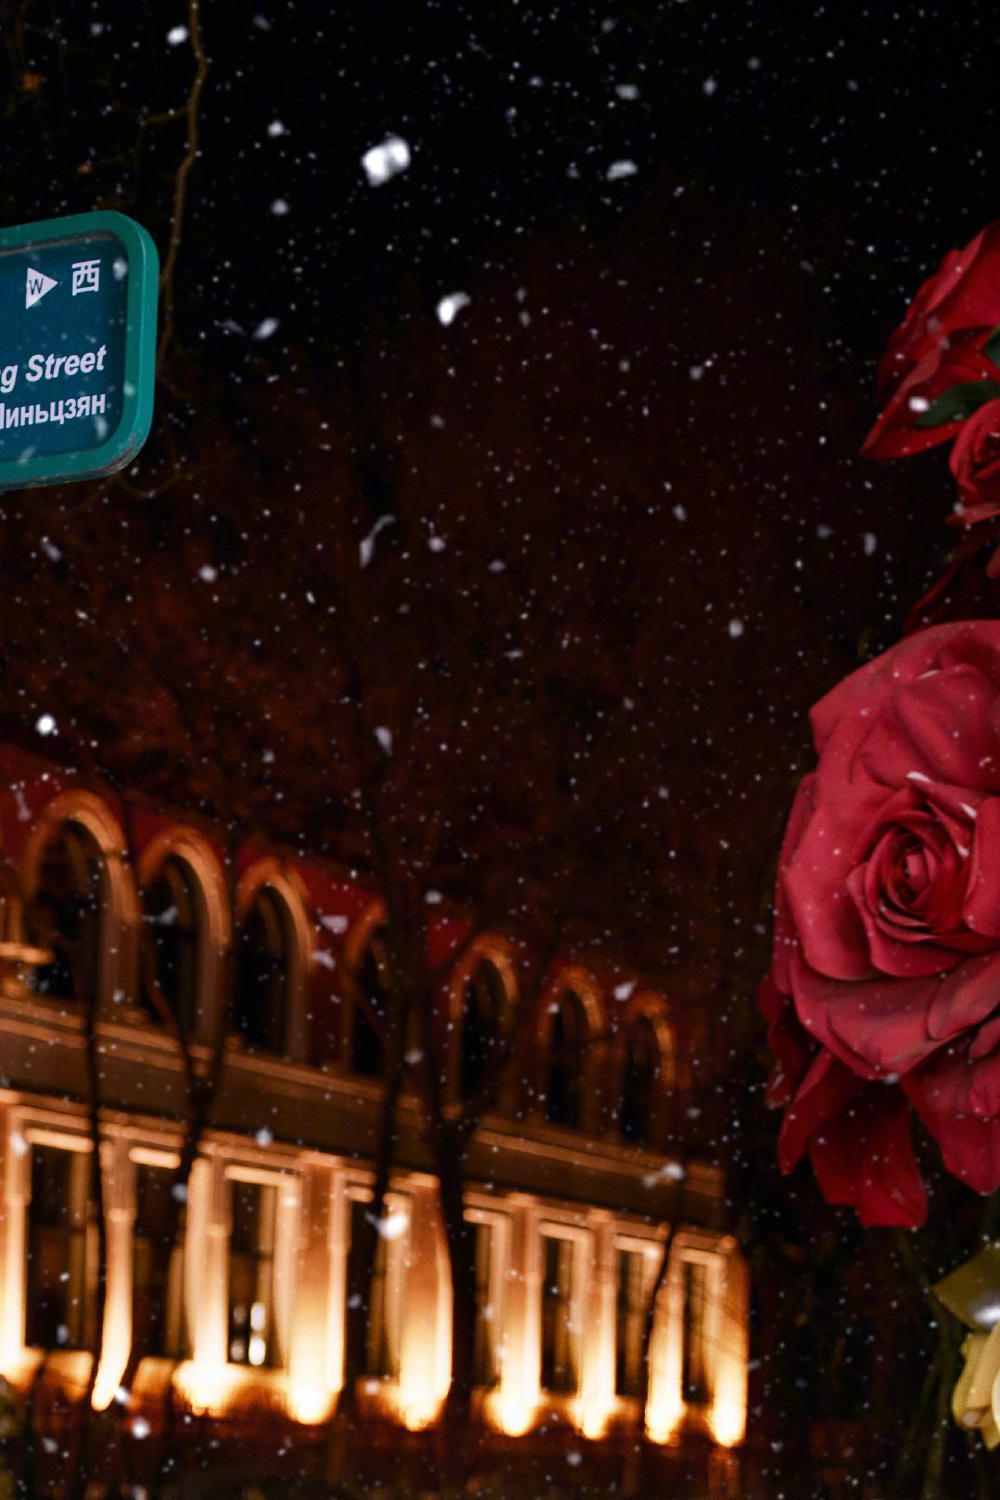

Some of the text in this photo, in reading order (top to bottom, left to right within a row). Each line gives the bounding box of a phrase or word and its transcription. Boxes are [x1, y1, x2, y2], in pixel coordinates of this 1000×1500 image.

[29, 278, 44, 296] W
[72, 259, 101, 296] 西
[25, 345, 107, 382] Street
